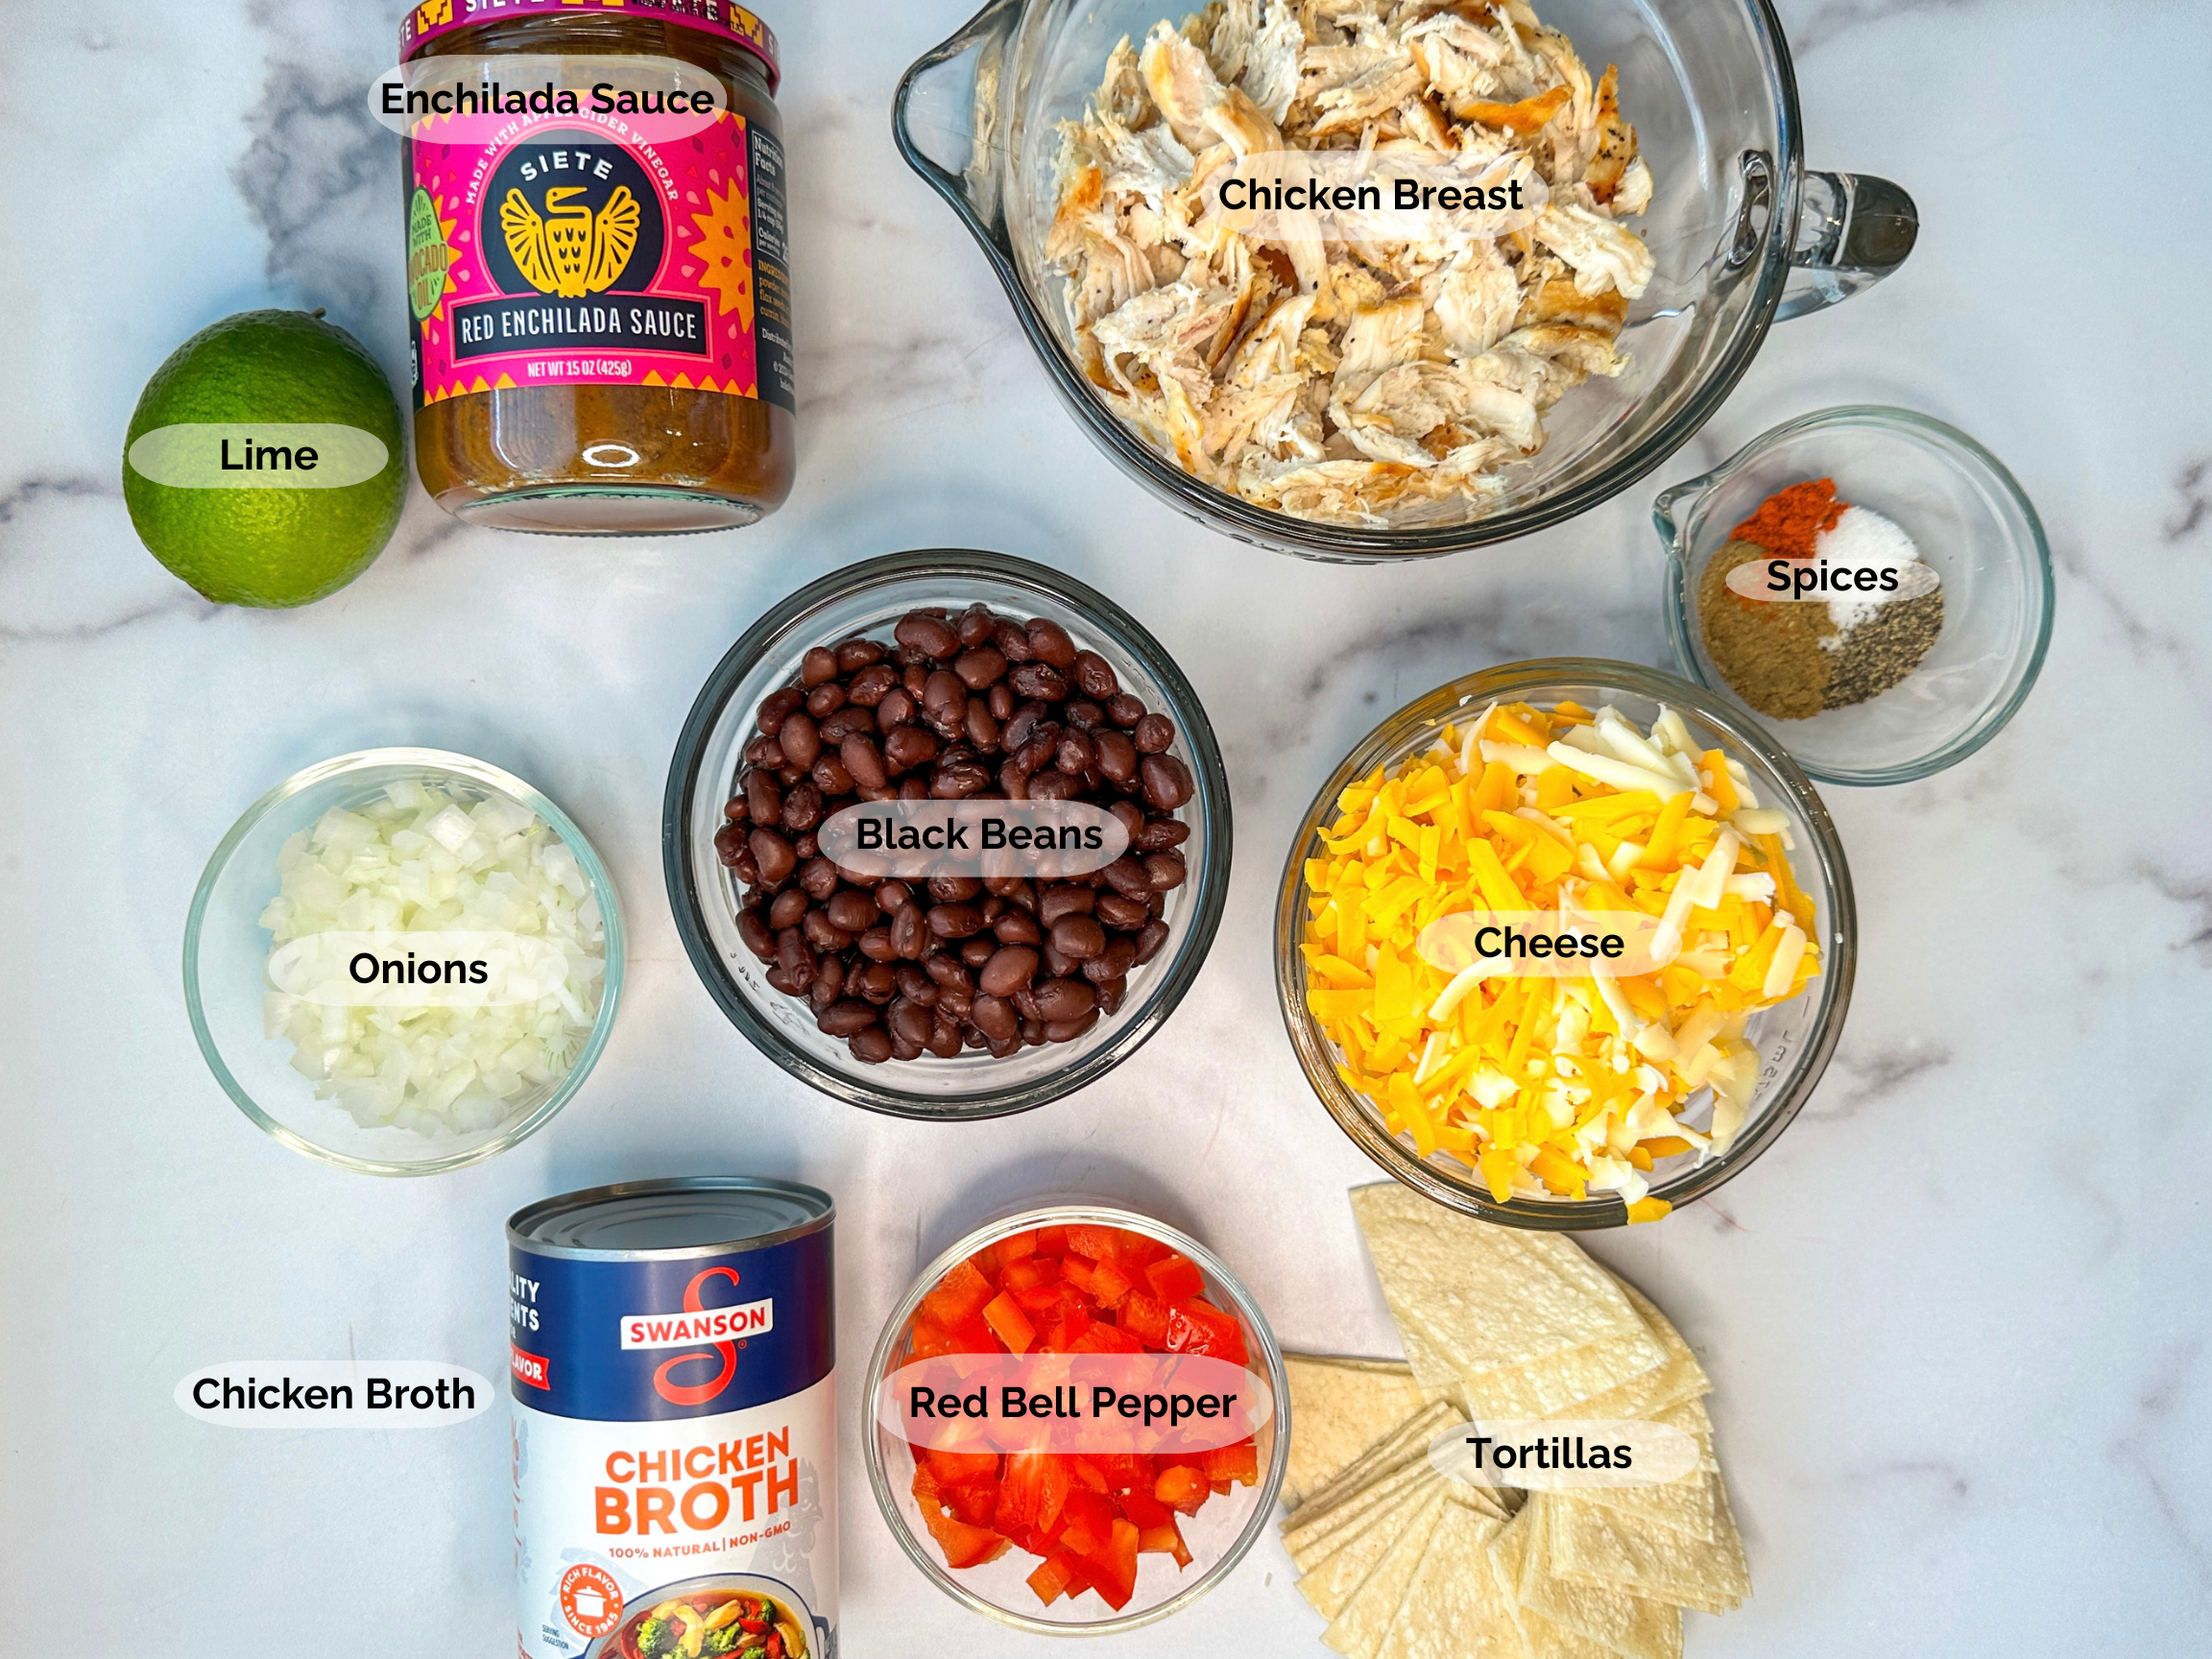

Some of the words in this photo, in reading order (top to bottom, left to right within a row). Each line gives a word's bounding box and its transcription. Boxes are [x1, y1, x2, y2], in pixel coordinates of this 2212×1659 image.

[466, 158, 489, 204] MADE
[485, 121, 520, 157] WITH
[578, 108, 629, 136] CIDER
[631, 132, 680, 202] VINEGAR
[520, 151, 613, 181] SIETE
[755, 152, 776, 177] Facts
[412, 213, 432, 236] MADE
[412, 229, 432, 248] WITH
[417, 279, 432, 311] OIL
[462, 315, 493, 344] RED
[503, 307, 622, 338] ENCHILADA
[631, 308, 697, 340] SAUCE
[527, 361, 545, 377] NET
[547, 360, 565, 376] WT
[566, 360, 580, 375] 15
[582, 360, 595, 375] OZ
[596, 358, 632, 377] (425g)
[631, 1307, 766, 1343] SWANSON
[606, 1426, 789, 1483] CHICKEN
[594, 1457, 799, 1536] BROTH
[609, 1547, 649, 1558] 100%
[653, 1542, 720, 1557] NATURAL
[730, 1521, 791, 1548] NON-GMO
[563, 1569, 581, 1594] RICH
[582, 1567, 619, 1599] FLAVOR
[565, 1605, 592, 1635] SINCE
[595, 1612, 618, 1635] 1945
